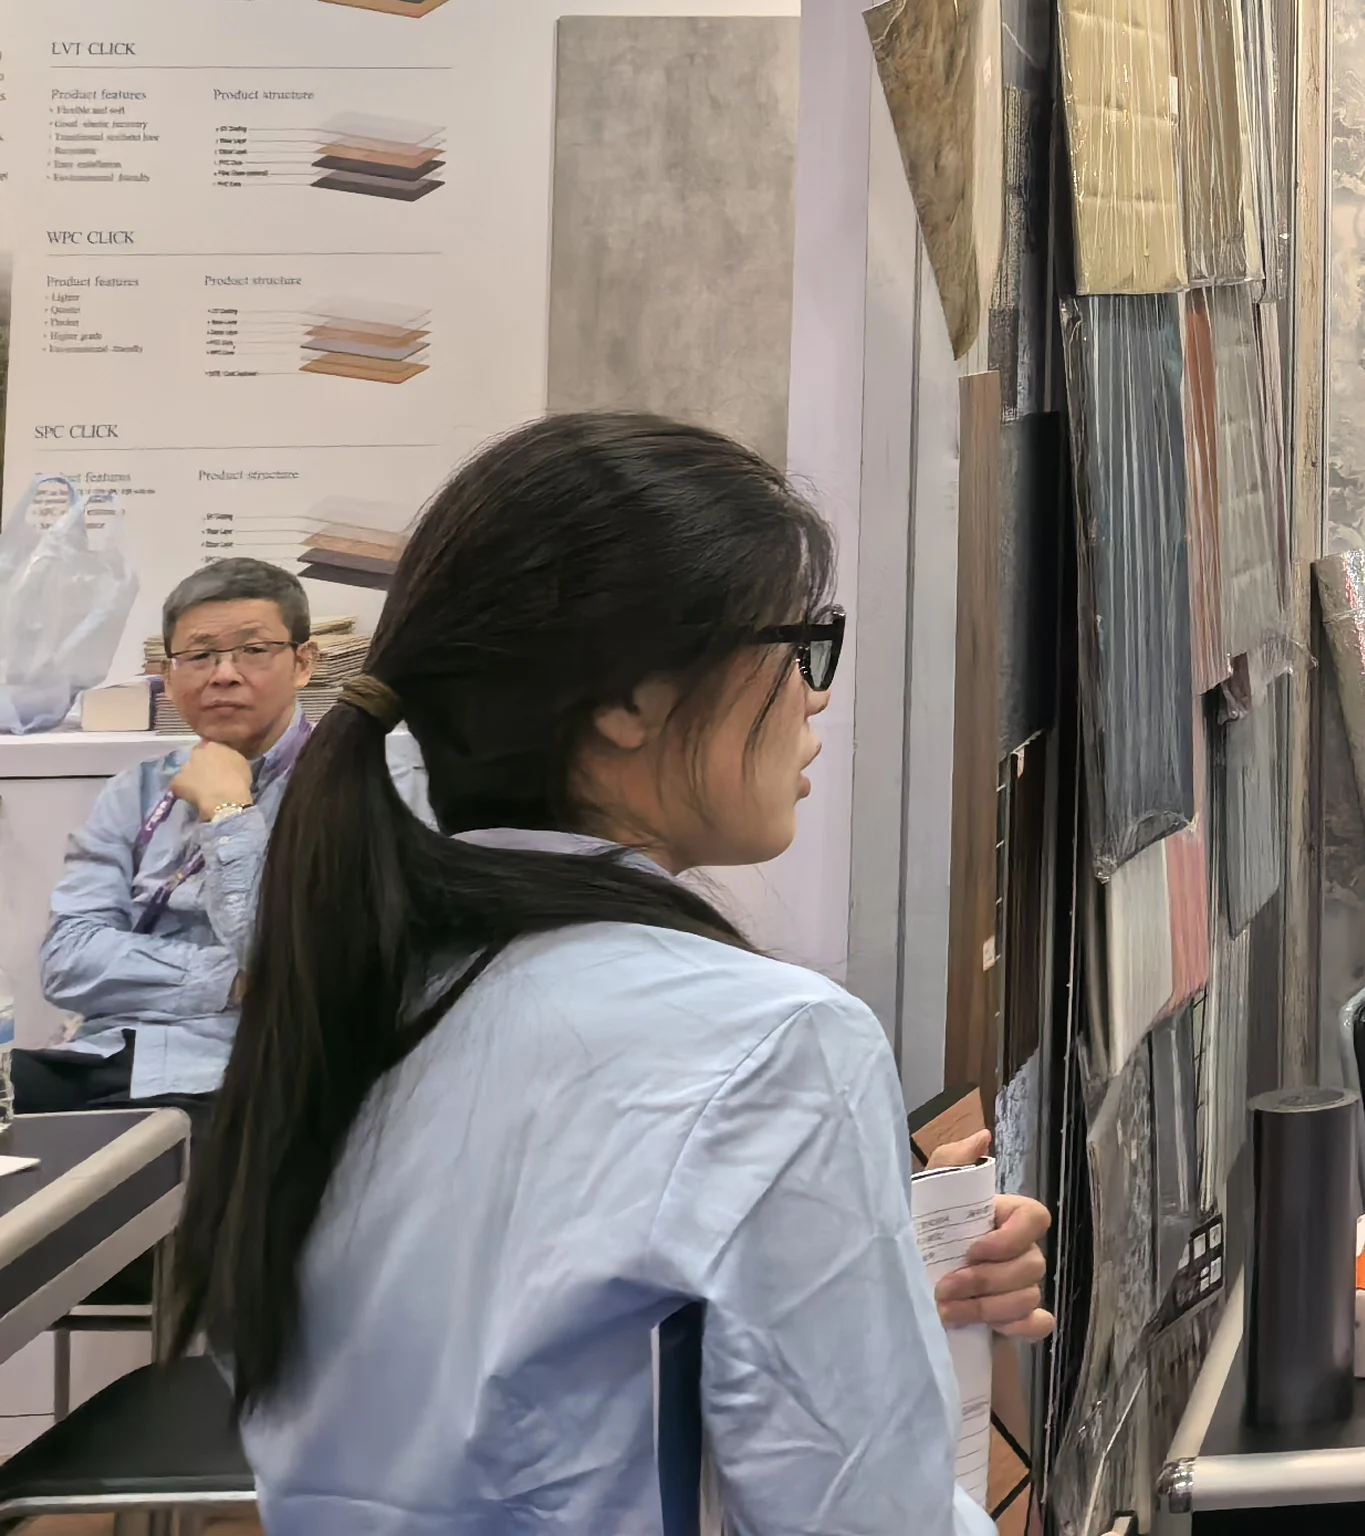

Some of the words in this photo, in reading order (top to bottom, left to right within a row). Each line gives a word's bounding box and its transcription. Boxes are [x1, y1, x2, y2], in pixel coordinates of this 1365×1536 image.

[51, 42, 80, 55] LVT
[88, 42, 136, 55] CLICK
[51, 89, 97, 101] Product
[101, 89, 147, 100] features
[213, 89, 259, 101] Product
[263, 90, 314, 100] structure
[46, 231, 82, 244] WPC
[87, 231, 135, 244] CLICK
[47, 276, 91, 287] Product
[95, 276, 139, 287] features
[205, 275, 249, 286] Product
[34, 425, 65, 439] SPC
[69, 424, 119, 439] CLICK
[198, 470, 243, 481] Product
